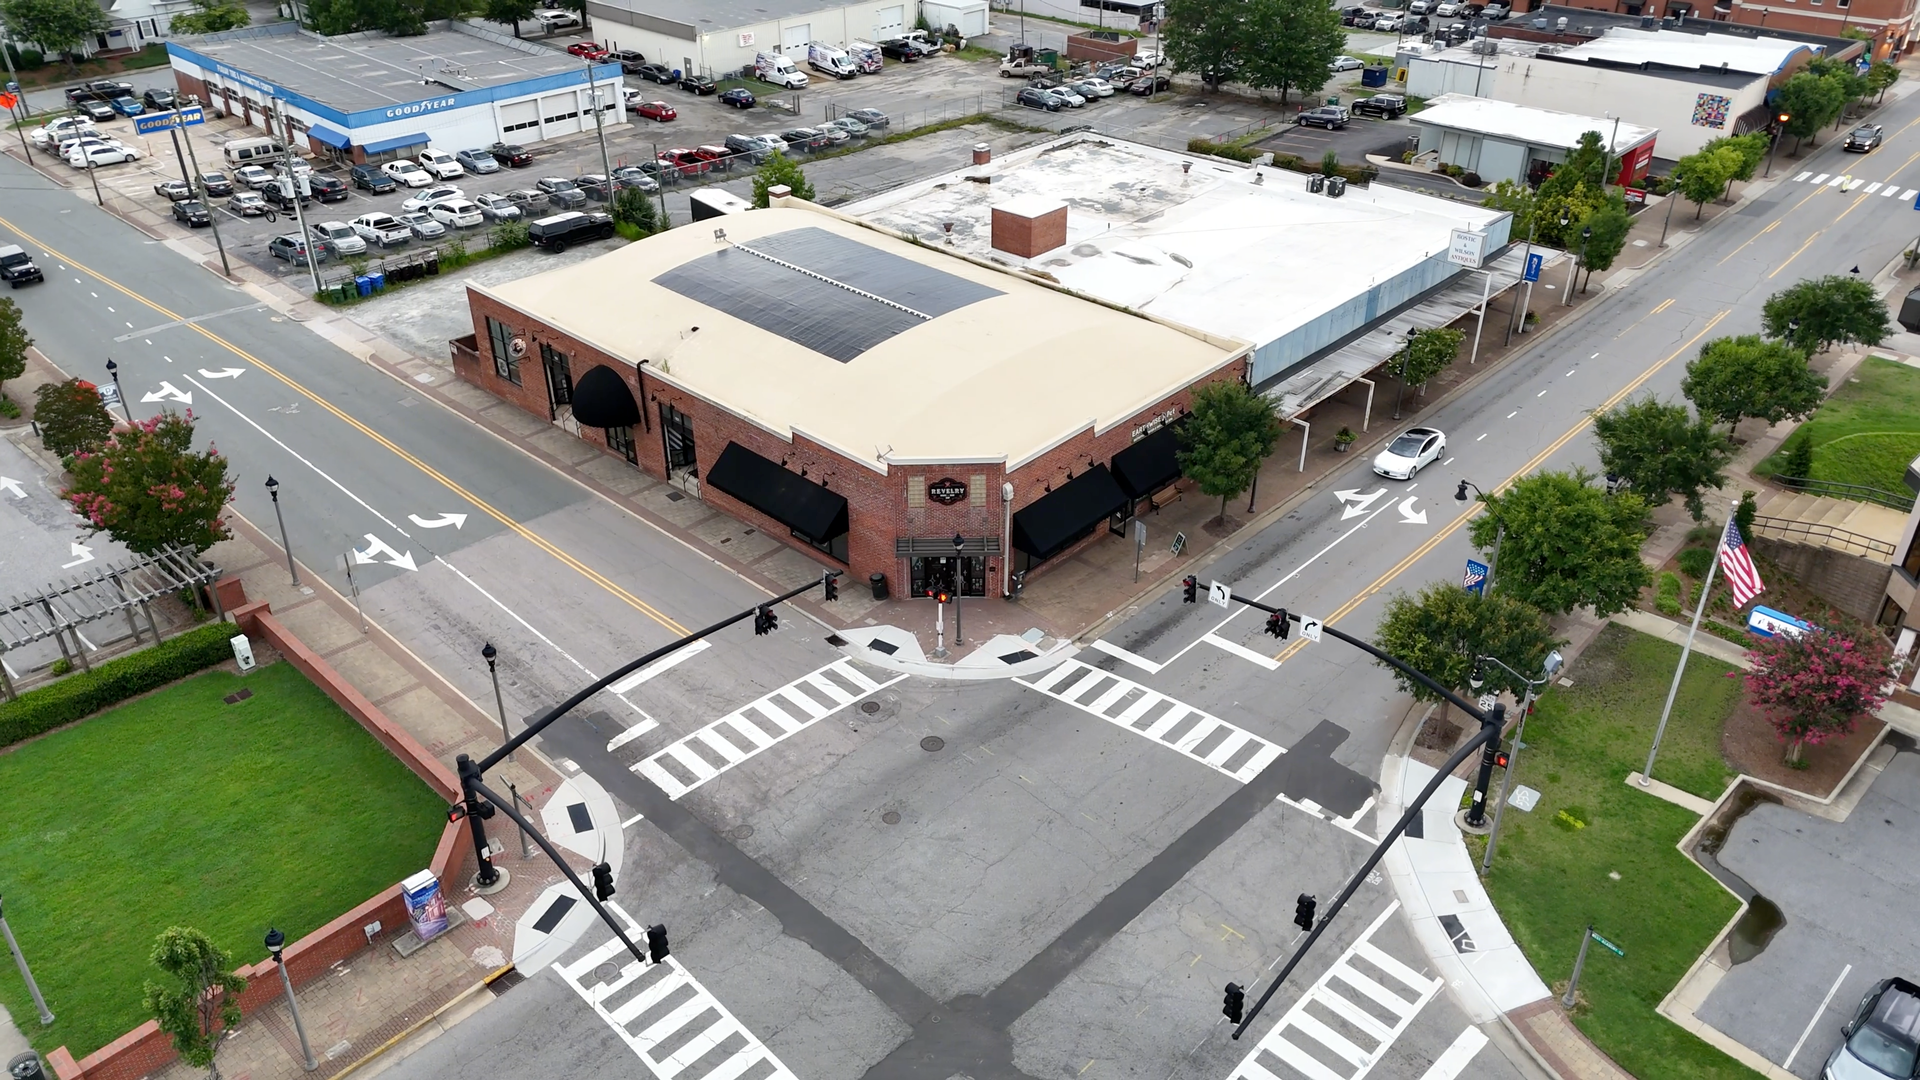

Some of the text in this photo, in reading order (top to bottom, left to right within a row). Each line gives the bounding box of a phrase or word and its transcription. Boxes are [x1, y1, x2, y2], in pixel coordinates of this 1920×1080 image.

[386, 98, 455, 118] GOODYEAR
[140, 112, 202, 130] GOODYEAR
[1454, 247, 1475, 257] WILSON
[1451, 254, 1477, 264] ANTIQUES
[1210, 596, 1226, 606] ONLY
[1301, 631, 1318, 640] ONLY
